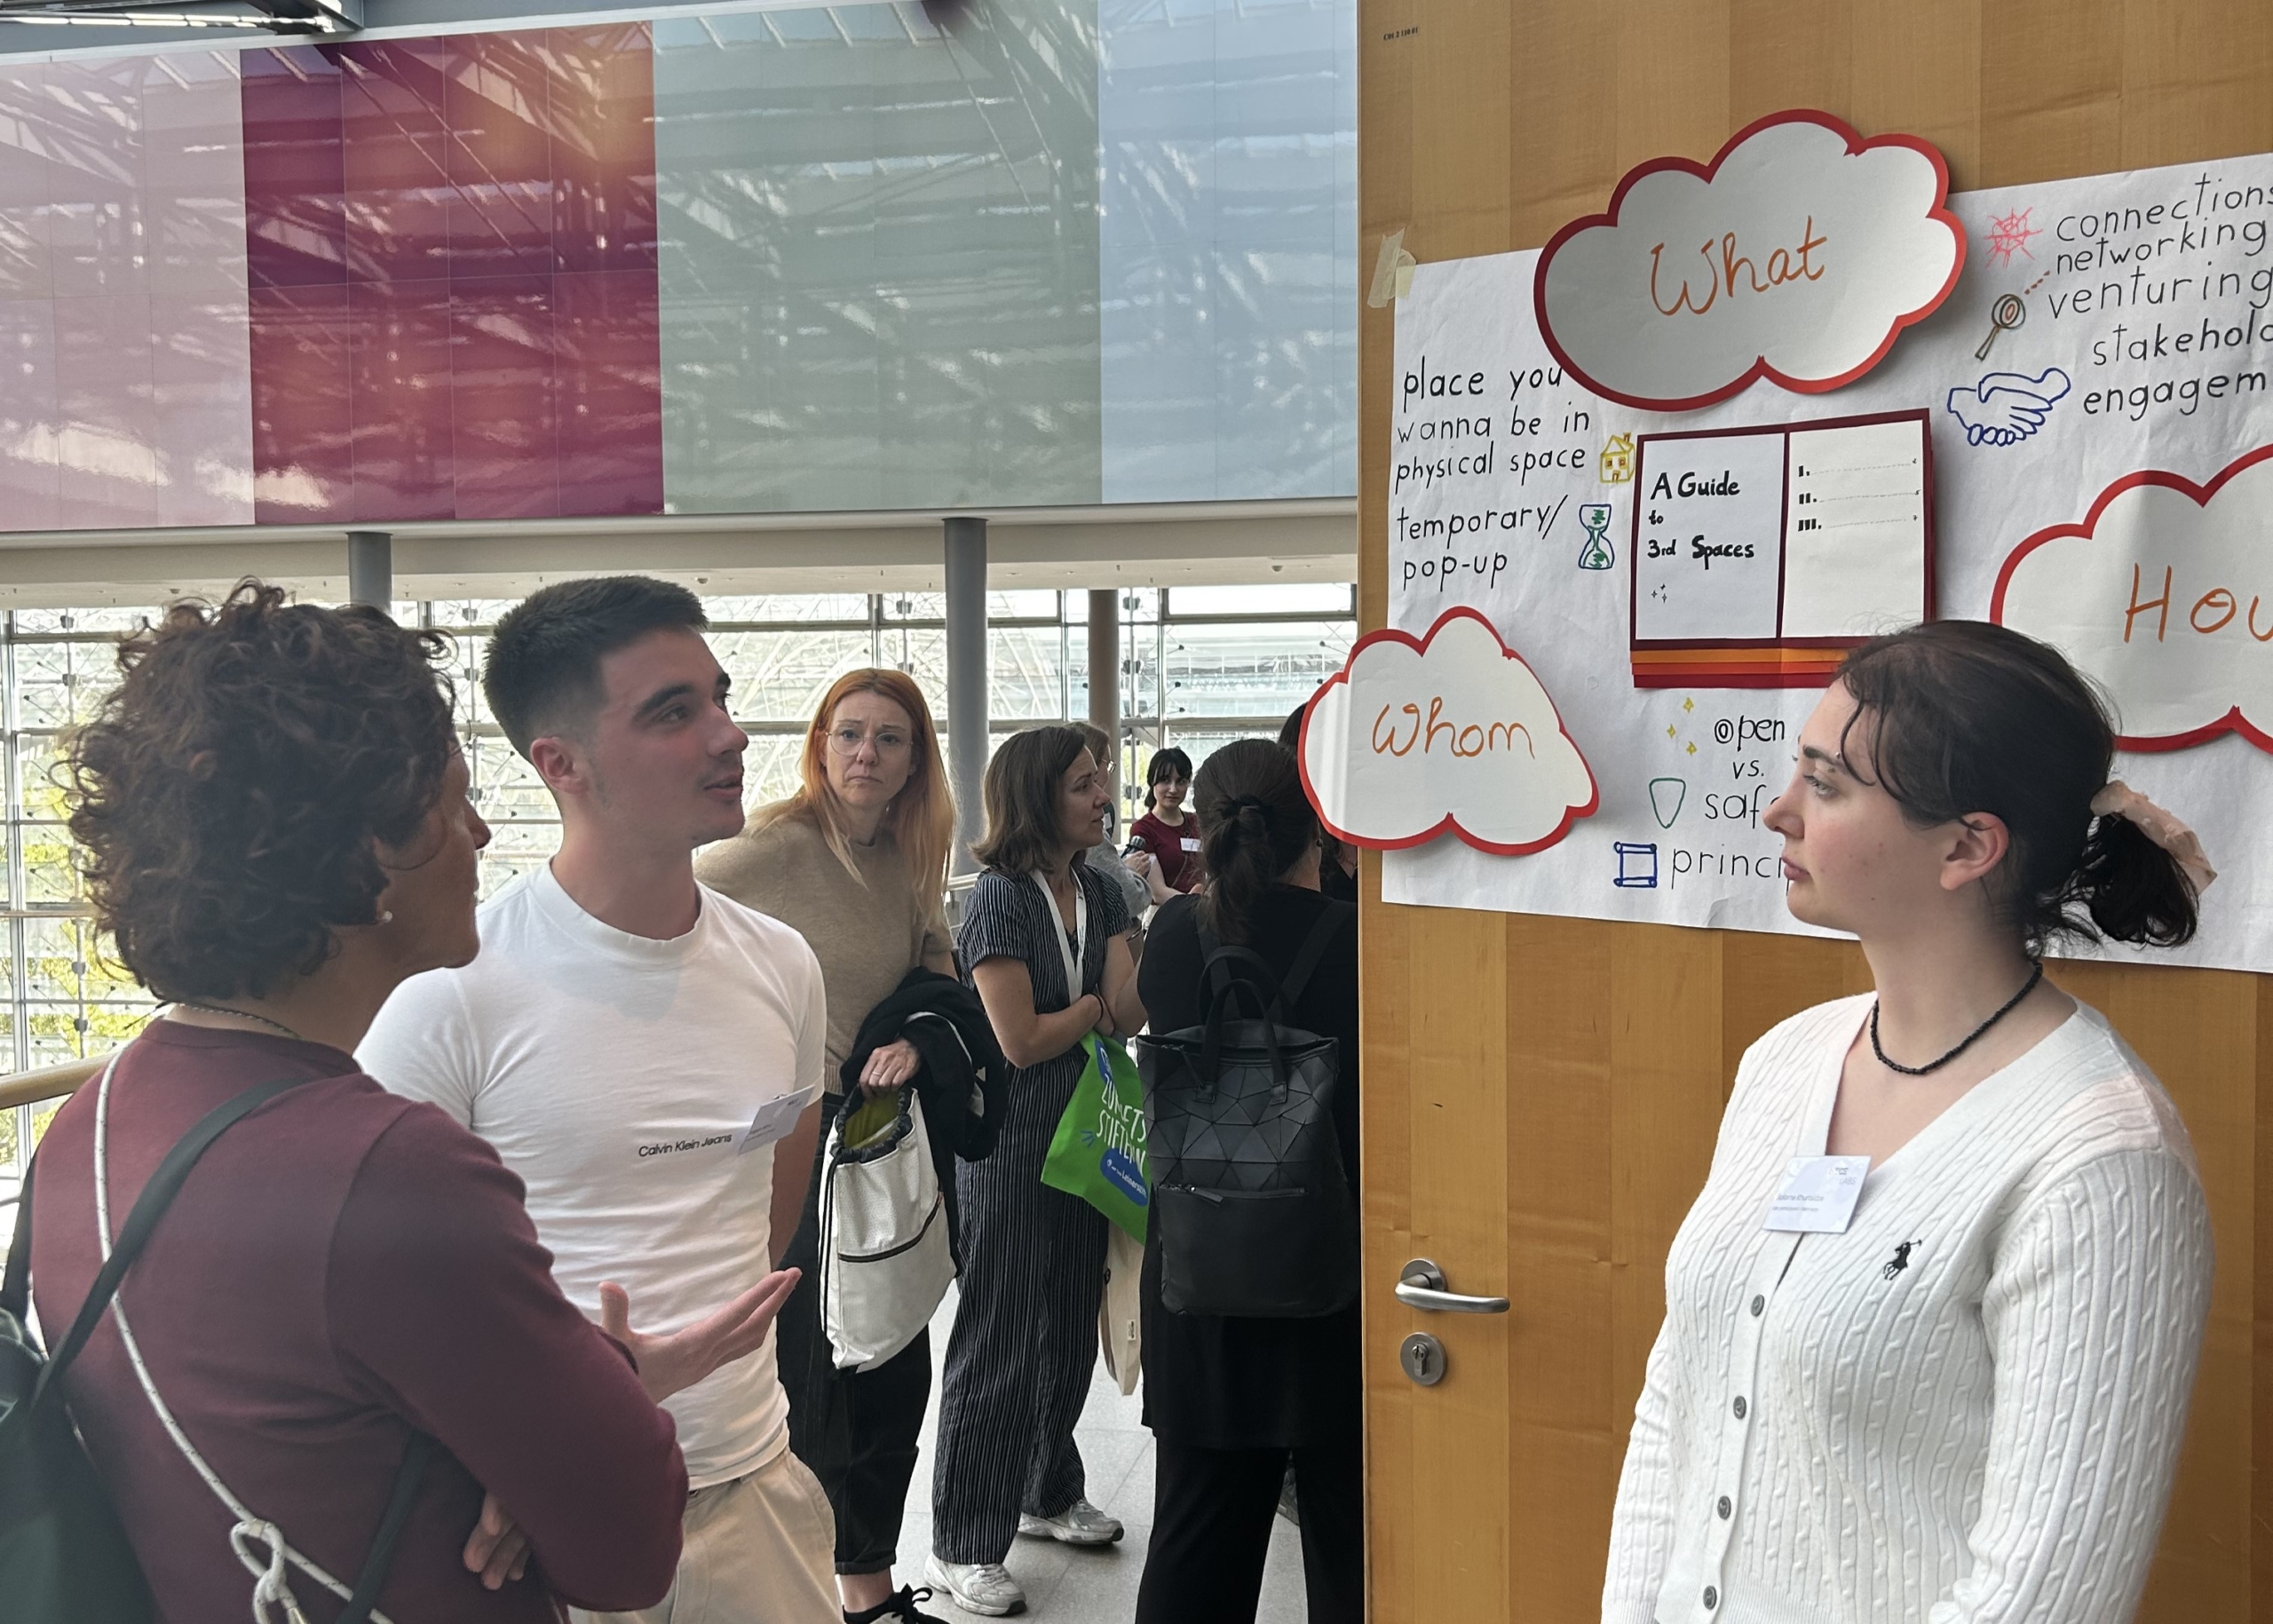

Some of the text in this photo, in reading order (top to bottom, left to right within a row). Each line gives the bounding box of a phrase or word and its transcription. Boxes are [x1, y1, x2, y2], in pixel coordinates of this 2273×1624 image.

[1651, 215, 1827, 316] What
[2057, 217, 2266, 274] networking
[2048, 261, 2273, 319] venturing
[1404, 355, 1563, 413] place you
[2084, 371, 2266, 422] engagem
[1398, 400, 1589, 443] wanna be in
[1395, 440, 1586, 495] physical space
[1650, 470, 1741, 501] A Guide
[1648, 510, 1665, 526] to
[1404, 551, 1508, 592] pop-up
[1647, 535, 1755, 571] 3rd Spaces
[1372, 696, 1536, 760] Whom
[1732, 759, 1765, 780] vs.
[1671, 843, 1790, 898] princi
[638, 1144, 674, 1158] Calvin
[675, 1138, 701, 1153] Klein
[701, 1133, 733, 1148] Jeans
